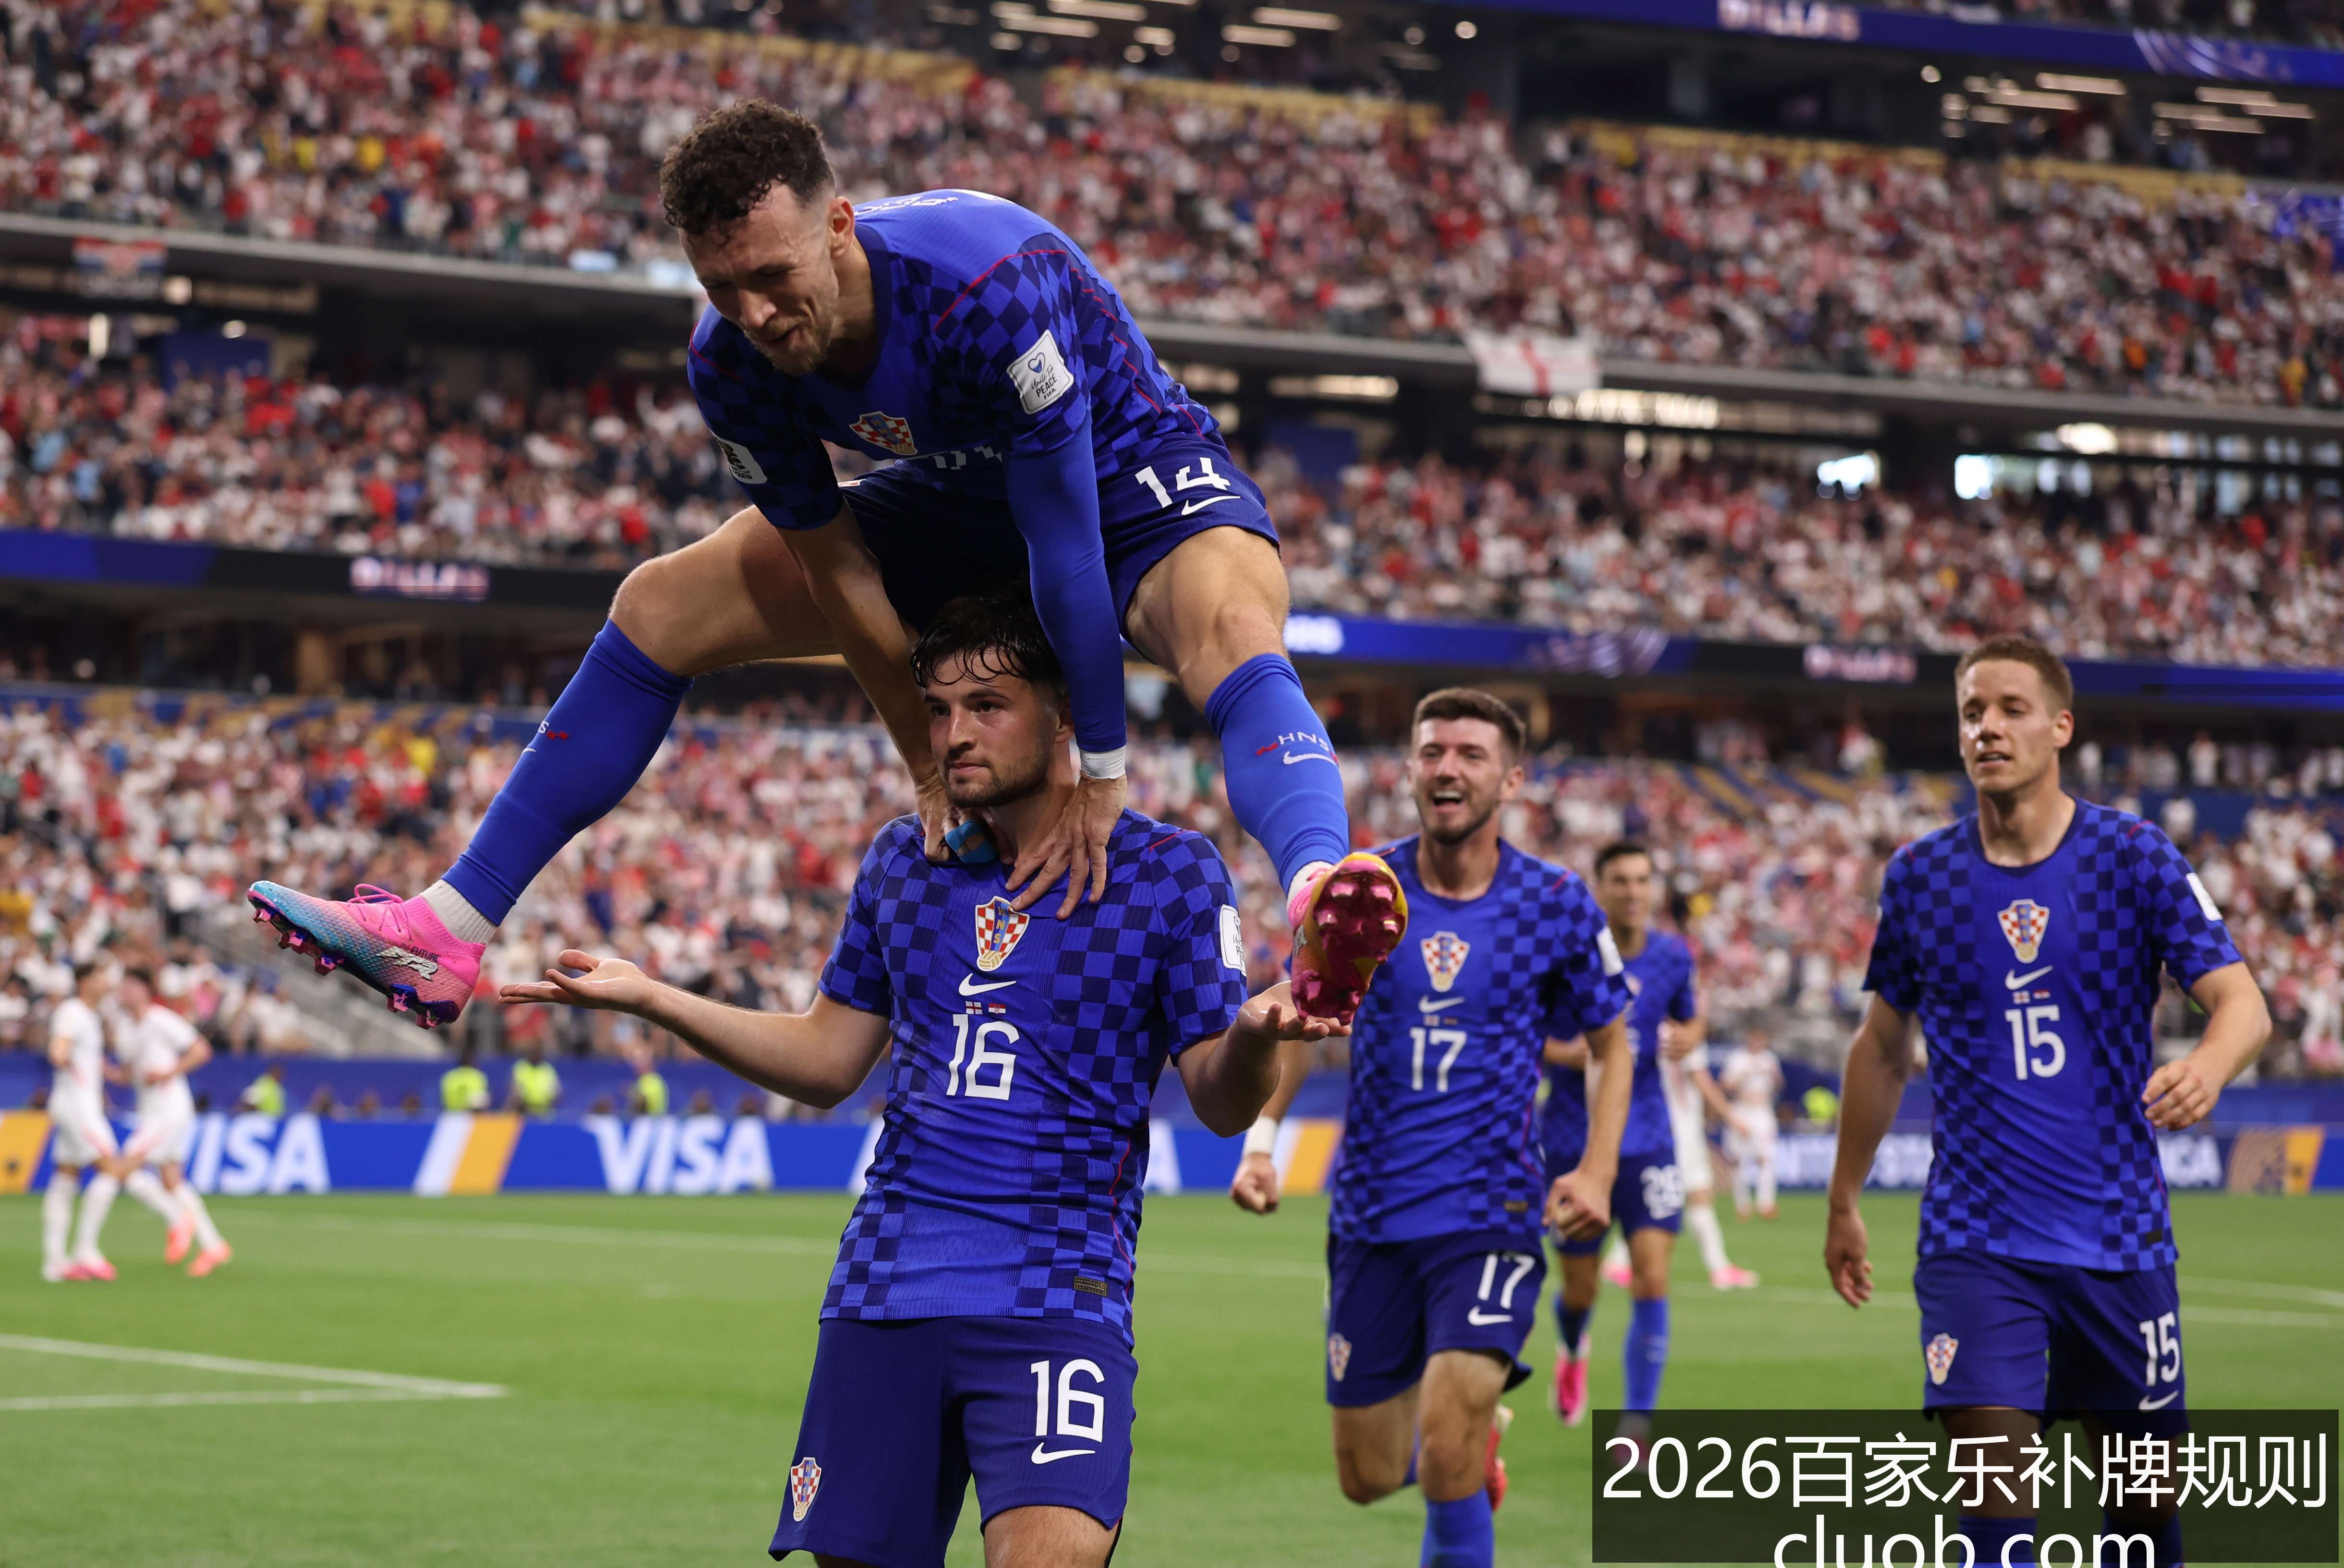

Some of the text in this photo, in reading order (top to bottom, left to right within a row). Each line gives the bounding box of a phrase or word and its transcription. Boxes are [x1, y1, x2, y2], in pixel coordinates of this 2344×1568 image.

[1036, 375, 1057, 397] PEACE
[1044, 389, 1055, 399] FIFA
[1135, 457, 1231, 508] 14
[1278, 731, 1329, 752] HNS
[410, 946, 441, 962] FUTURE
[946, 1013, 1020, 1100] 16
[1409, 1026, 1467, 1093] 17
[2004, 1004, 2066, 1080] 15
[579, 1112, 775, 1196] VISA
[1477, 1253, 1536, 1310] 17
[2139, 1311, 2181, 1387] 15
[1031, 1359, 1105, 1443] 16
